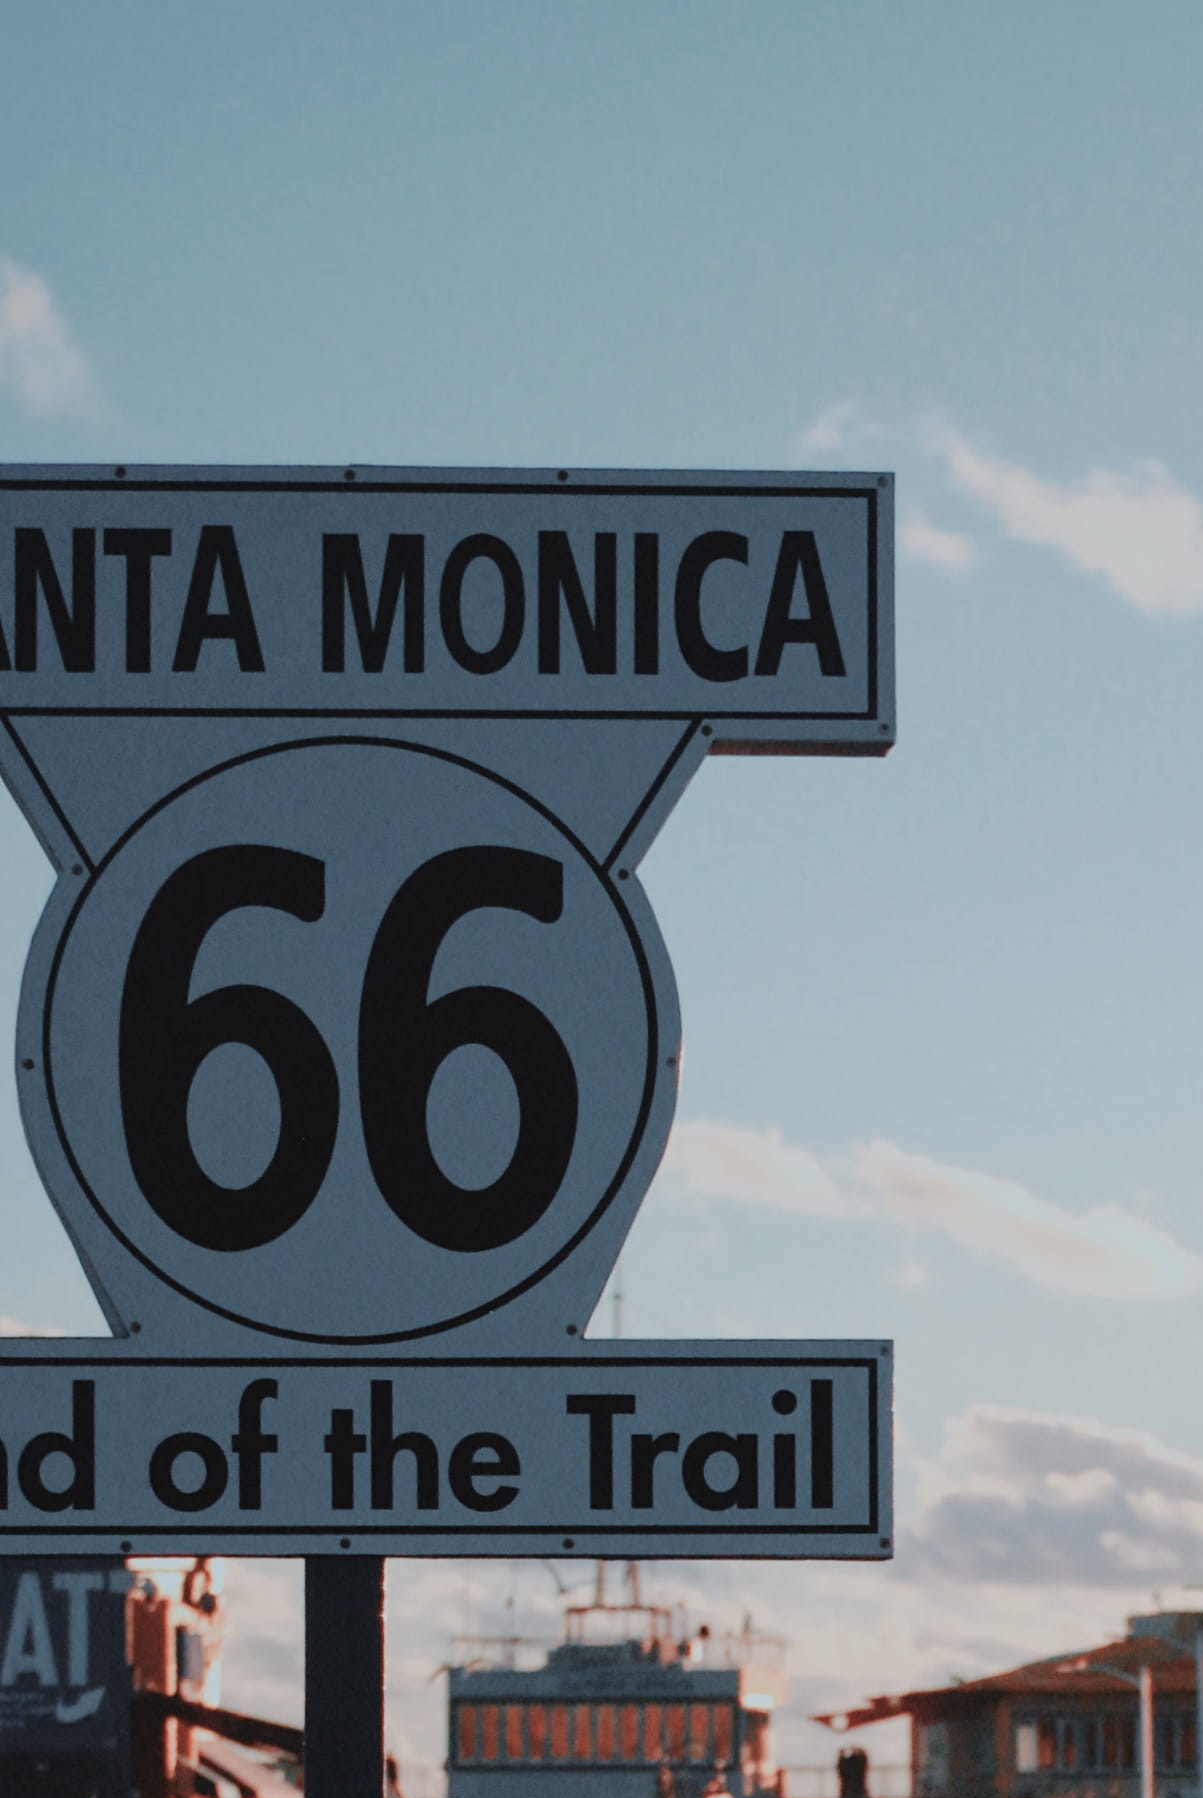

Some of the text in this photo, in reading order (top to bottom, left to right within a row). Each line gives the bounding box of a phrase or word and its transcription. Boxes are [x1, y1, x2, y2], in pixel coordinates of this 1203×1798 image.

[0, 524, 846, 682] NTA MONICA
[118, 844, 579, 1254] 66
[0, 1378, 833, 1512] d of the Trail
